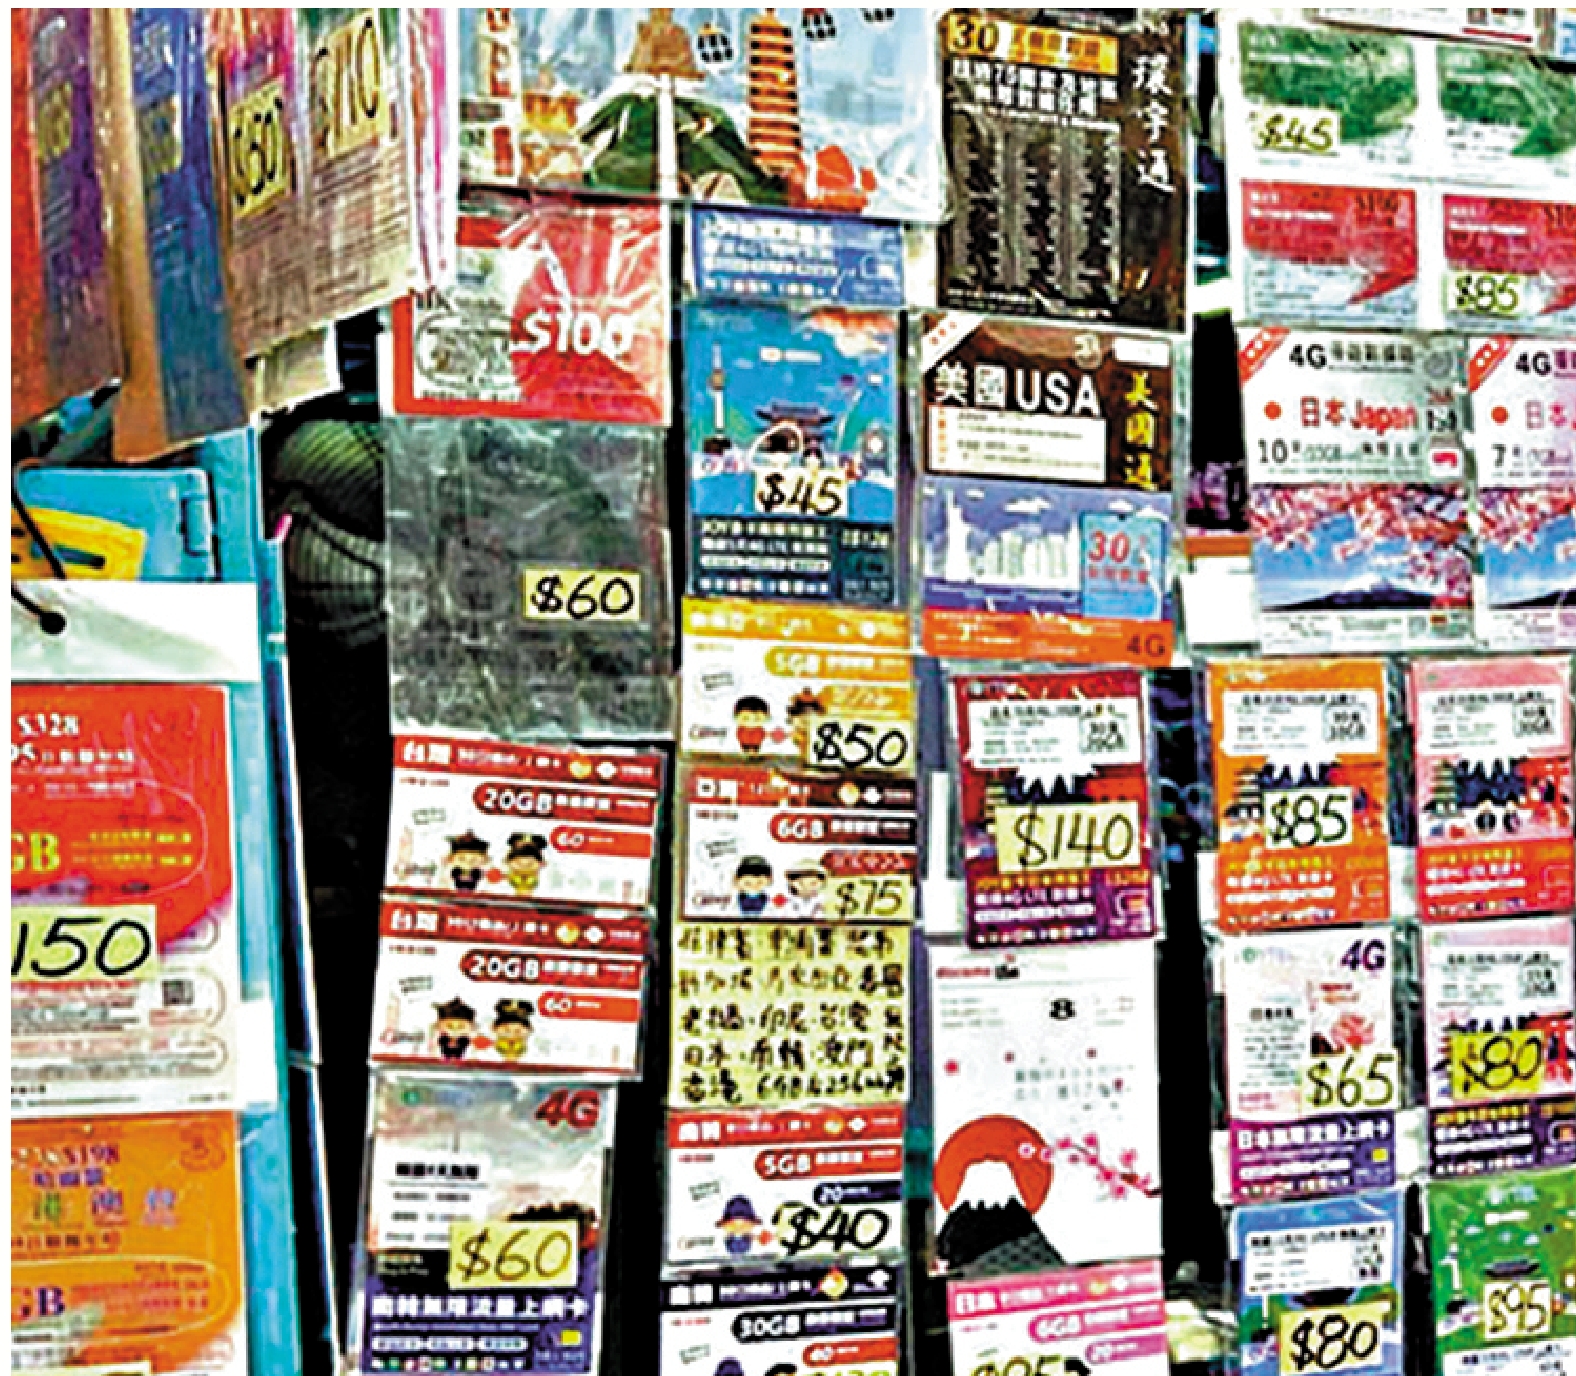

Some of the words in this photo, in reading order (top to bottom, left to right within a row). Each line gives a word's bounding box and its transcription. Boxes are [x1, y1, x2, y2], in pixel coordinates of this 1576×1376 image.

[953, 20, 998, 53] 30
[1257, 115, 1334, 151] $45
[523, 311, 634, 354] $100
[1288, 344, 1327, 368] 4G
[1515, 352, 1551, 375] 4G
[1014, 368, 1099, 416] USA
[1300, 397, 1343, 428] 日本
[1349, 403, 1417, 434] Japan
[757, 473, 844, 516] $45
[530, 575, 635, 618] $60
[1126, 634, 1166, 657] 4G
[813, 721, 909, 769] $50
[482, 790, 553, 815] 20GB
[1271, 794, 1348, 847] $85
[1014, 803, 1134, 868] $140
[836, 880, 904, 917] $75
[469, 955, 539, 980] 20GB
[1342, 940, 1387, 970] 4G
[1049, 998, 1076, 1020] 8
[1308, 1054, 1395, 1107] $65
[1460, 1037, 1542, 1093] $80
[536, 1088, 599, 1128] 4G
[457, 1227, 572, 1281] $60
[740, 1312, 800, 1338] 30GB
[1488, 1282, 1547, 1334] $95
[1292, 1314, 1378, 1369] $80
